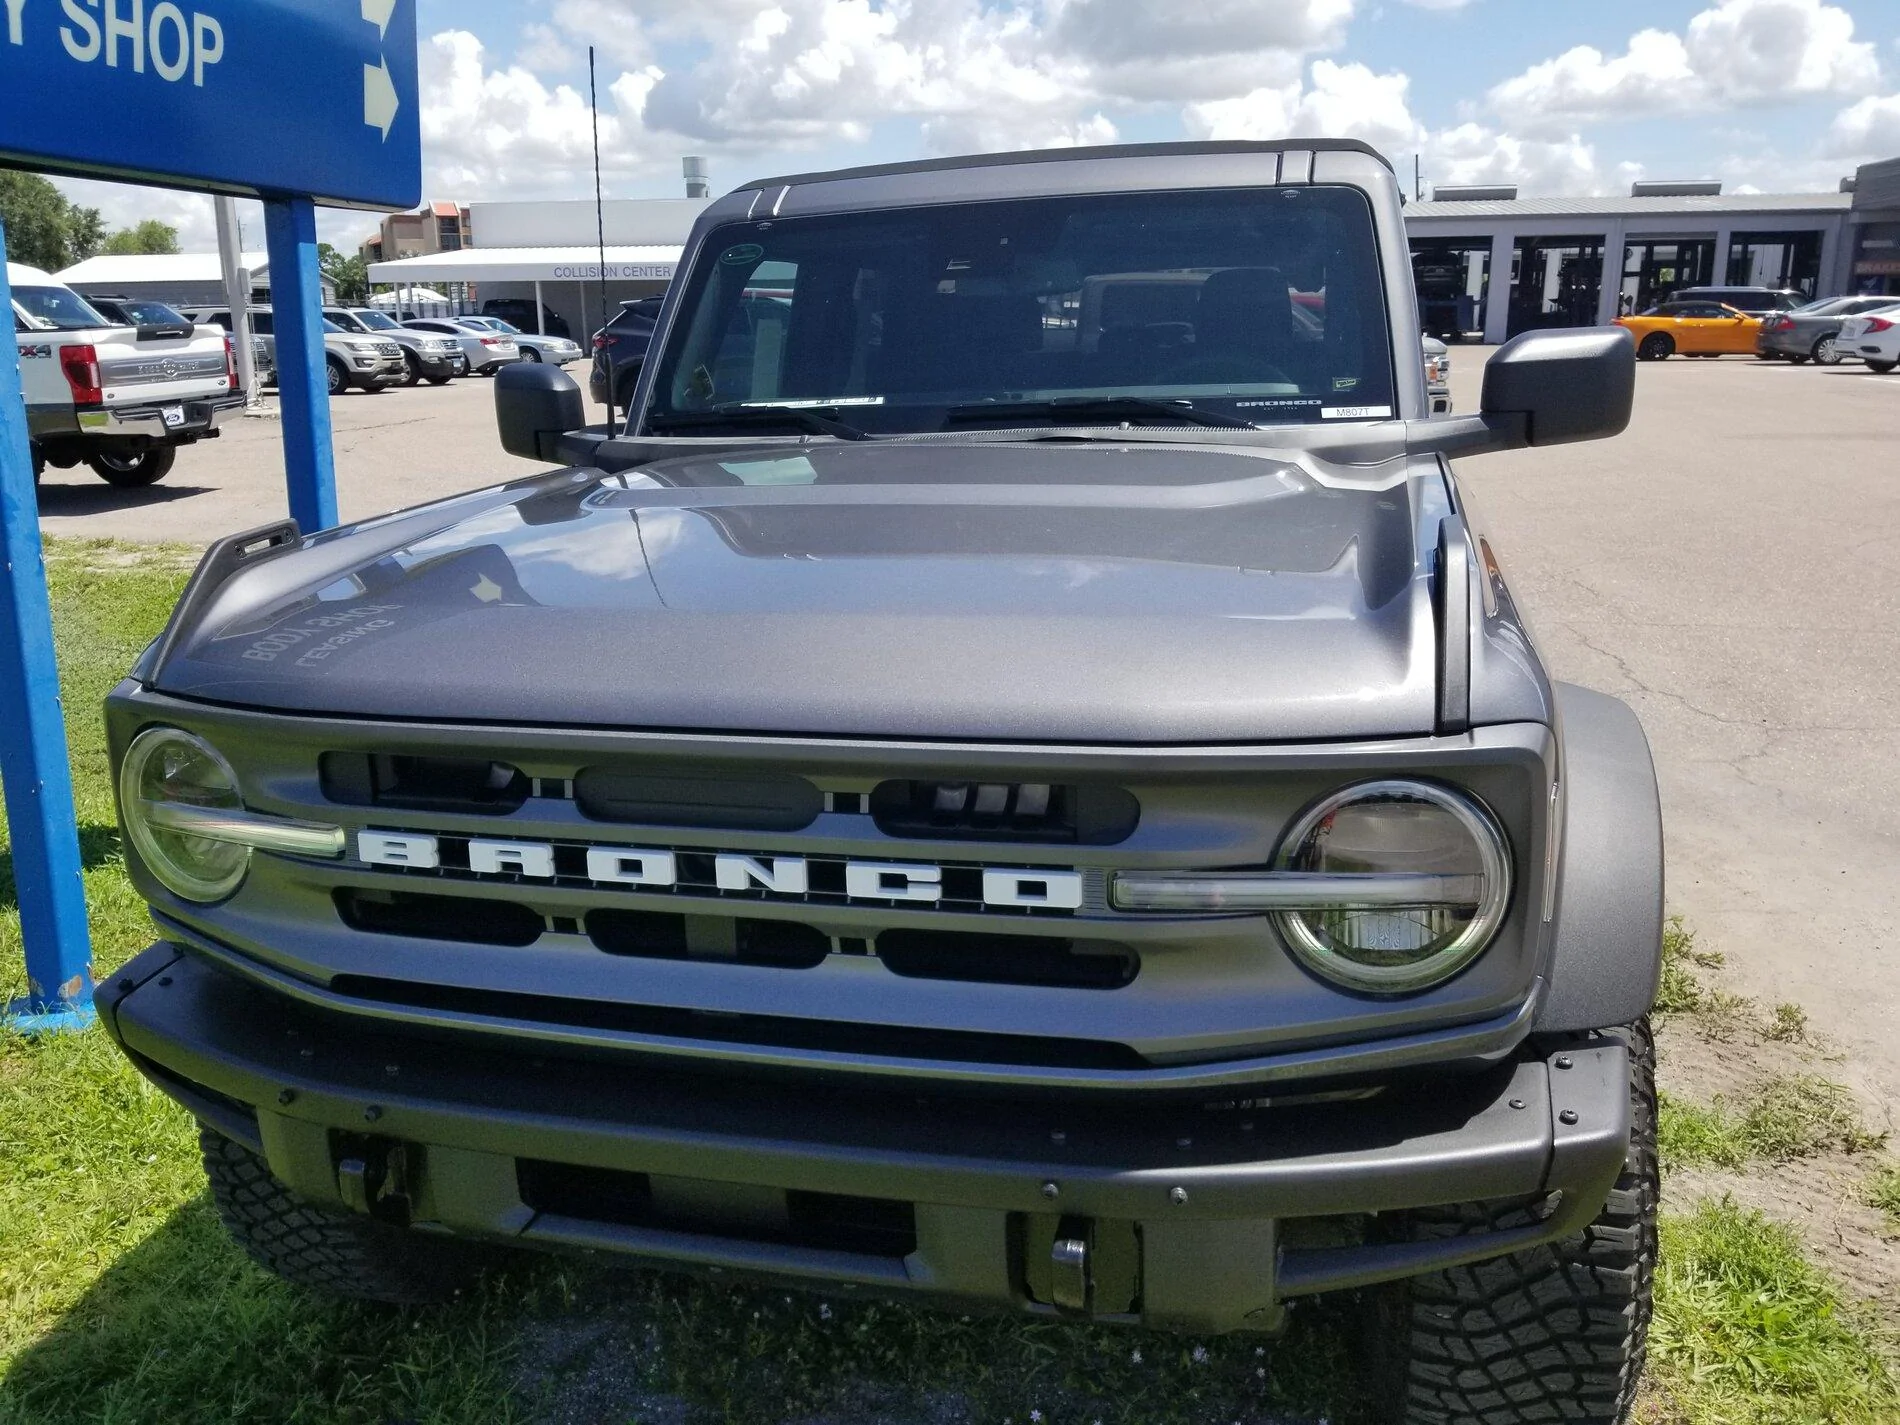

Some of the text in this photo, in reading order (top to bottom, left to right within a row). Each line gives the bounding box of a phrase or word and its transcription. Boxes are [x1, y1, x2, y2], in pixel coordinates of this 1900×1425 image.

[59, 0, 224, 87] SHOP
[554, 265, 671, 278] COLLISION CENTER
[357, 828, 1083, 910] BRONCO
